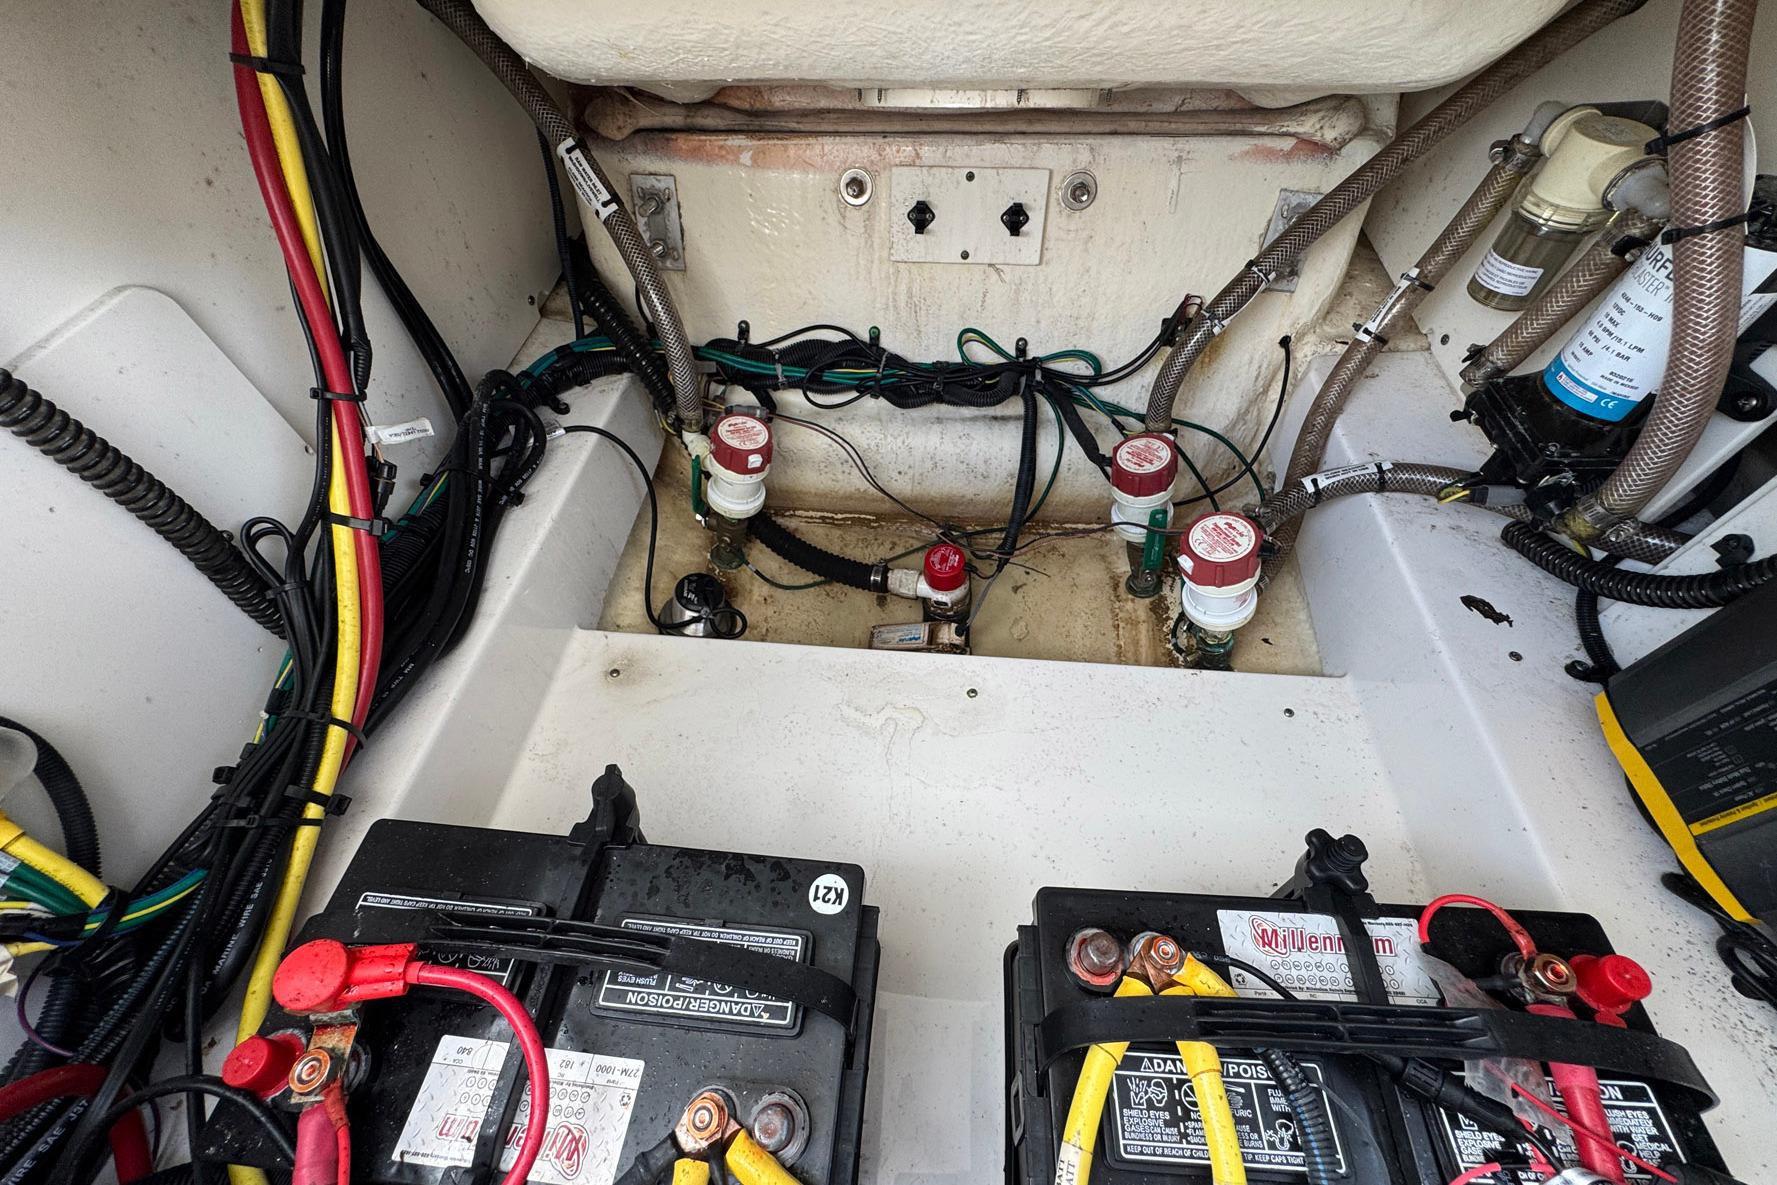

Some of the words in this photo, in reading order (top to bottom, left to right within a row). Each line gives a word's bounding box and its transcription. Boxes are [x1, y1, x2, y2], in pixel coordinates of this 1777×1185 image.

[812, 885, 844, 906] K21
[212, 932, 240, 975] MARINE
[238, 904, 254, 928] WIRE
[250, 881, 264, 900] SAE
[617, 975, 636, 984] EYES
[636, 978, 657, 986] FLUSH
[626, 992, 750, 1016] DANGER/POISON
[456, 1046, 474, 1056] 840
[560, 1059, 574, 1069] 182
[595, 1064, 640, 1078] 27M-1000
[1123, 1109, 1148, 1118] SHIELD
[1150, 1110, 1170, 1120] EYES
[1626, 1110, 1650, 1119] EYES
[38, 1126, 66, 1153] SAE
[69, 1100, 89, 1122] J37
[1124, 1117, 1164, 1127] EXPLOSIVE
[1125, 1124, 1150, 1133] GASES
[1162, 1127, 1178, 1135] CAUSE
[1630, 1126, 1659, 1135] WATER
[1124, 1132, 1152, 1140] BLINDNESS
[1162, 1134, 1180, 1142] INJURY
[1454, 1130, 1482, 1140] SHIELD
[1631, 1134, 1648, 1142] GET
[1244, 1140, 1263, 1148] BURNS
[1458, 1139, 1502, 1150] EXPLOSIVE
[1635, 1142, 1672, 1152] MEDICAL
[1126, 1145, 1142, 1154] KEEP
[1143, 1146, 1154, 1154] OUT
[1164, 1148, 1183, 1156] REACH
[1254, 1154, 1270, 1162] KEEP
[1286, 1156, 1304, 1164] TIGHT
